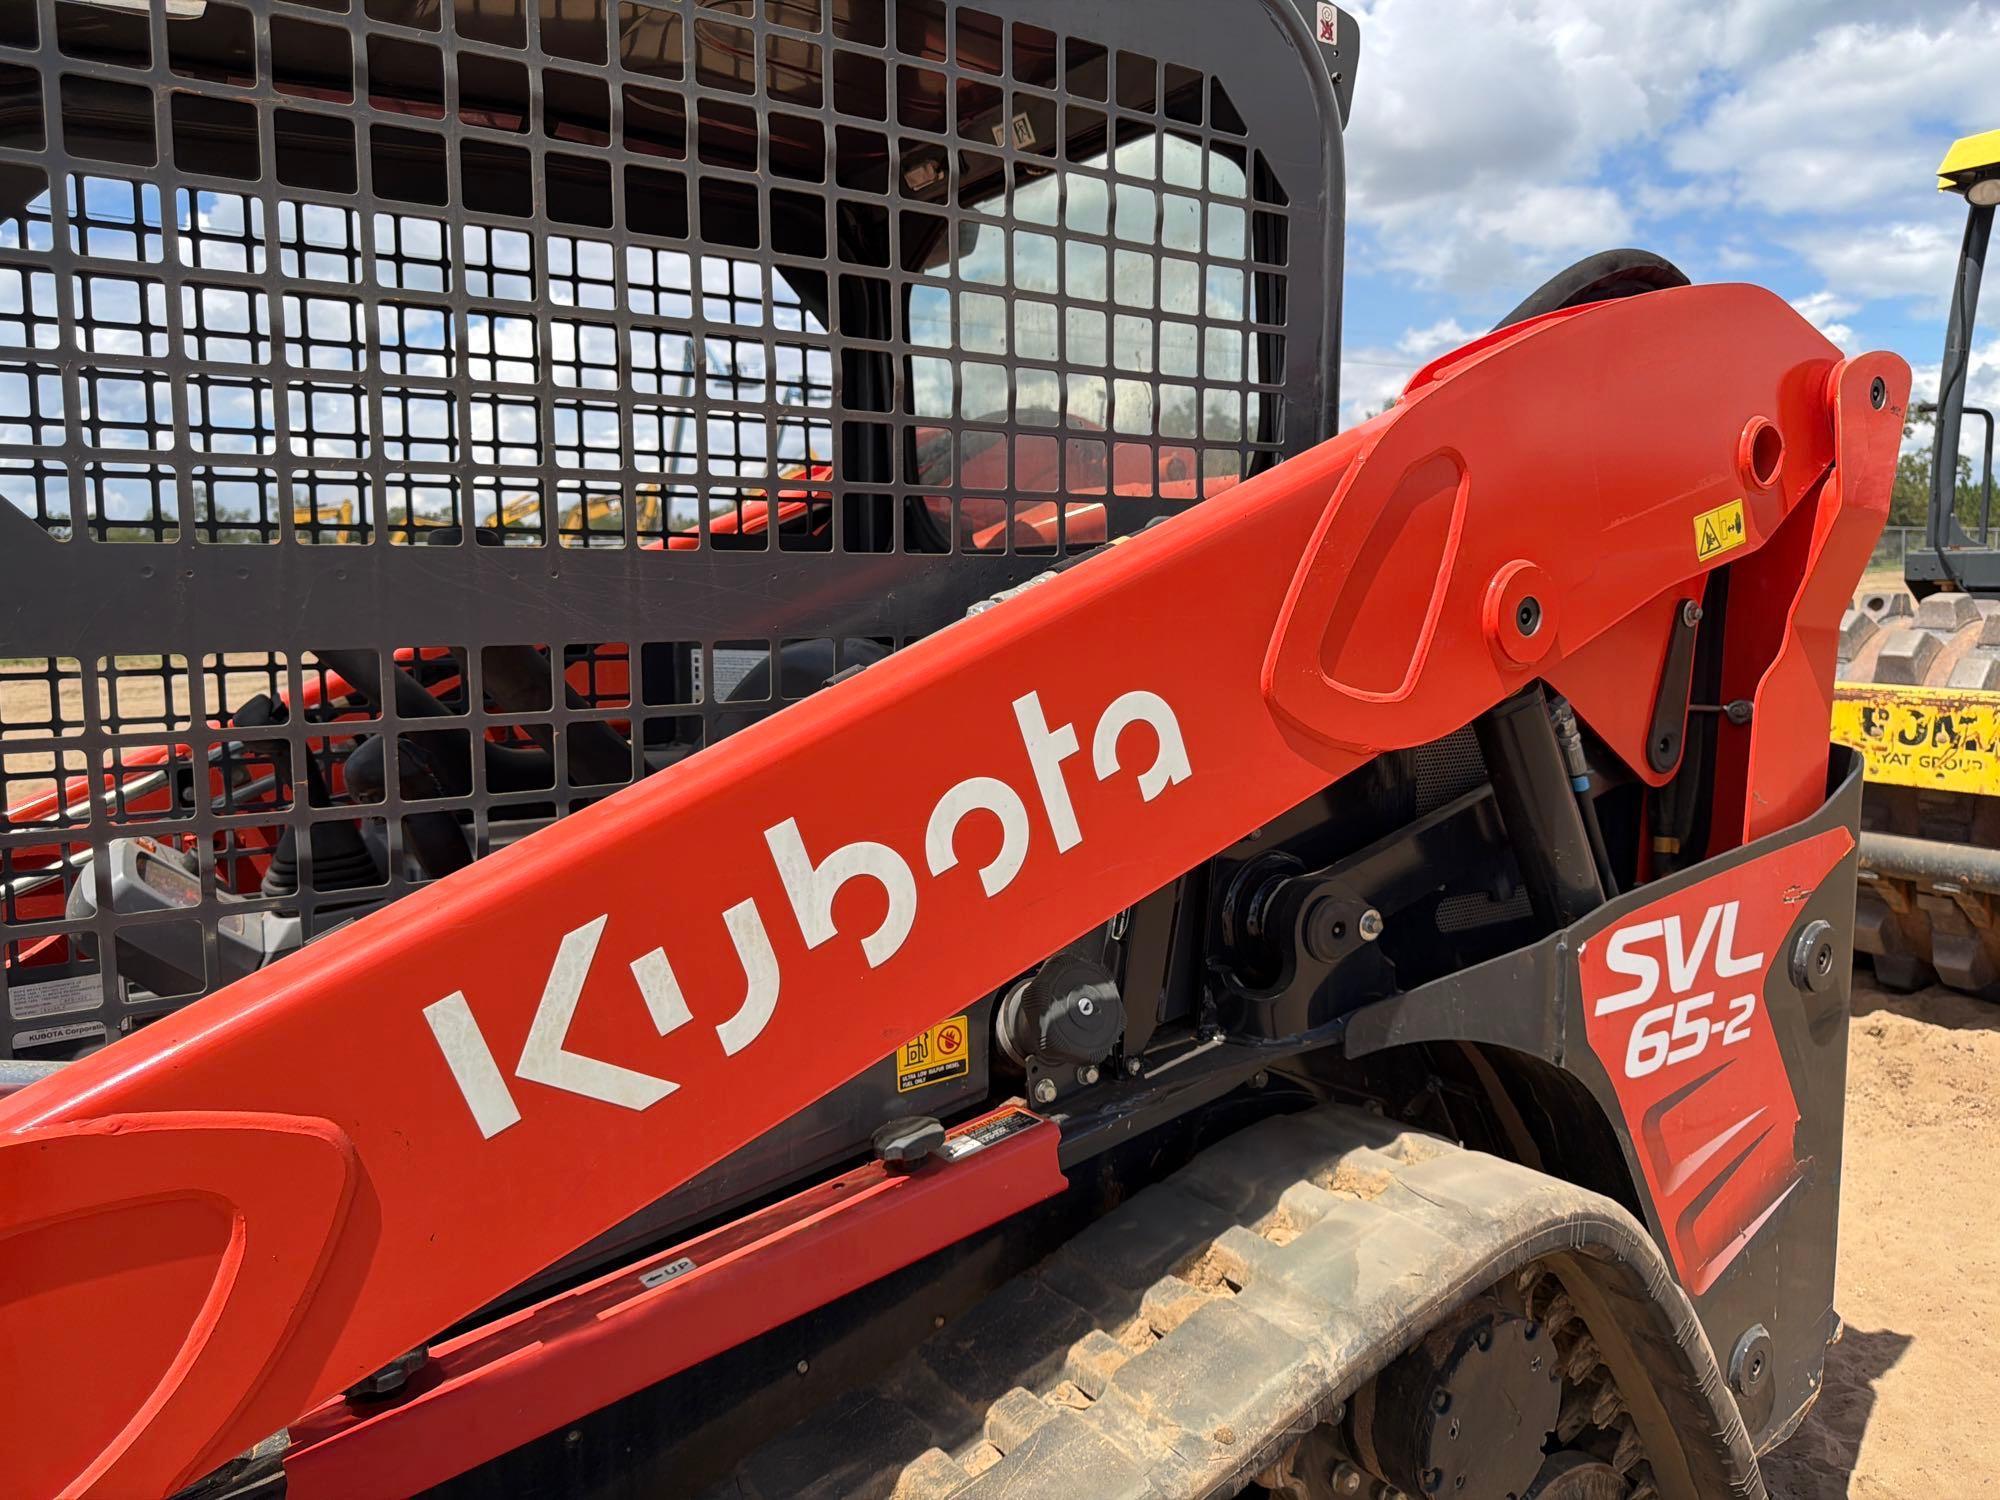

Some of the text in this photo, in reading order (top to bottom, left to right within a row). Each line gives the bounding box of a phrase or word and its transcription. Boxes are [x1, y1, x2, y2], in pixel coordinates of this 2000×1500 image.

[422, 690, 1192, 1140] Kubota
[1595, 900, 1764, 1017] SVL
[29, 1030, 64, 1042] KUBOTA
[1624, 991, 1756, 1079] 65-2
[910, 1051, 917, 1060] D
[902, 1073, 916, 1083] ULTRA
[917, 1070, 928, 1079] LOW
[902, 1077, 927, 1089] FUEL ONLY
[664, 1261, 689, 1275] UP
